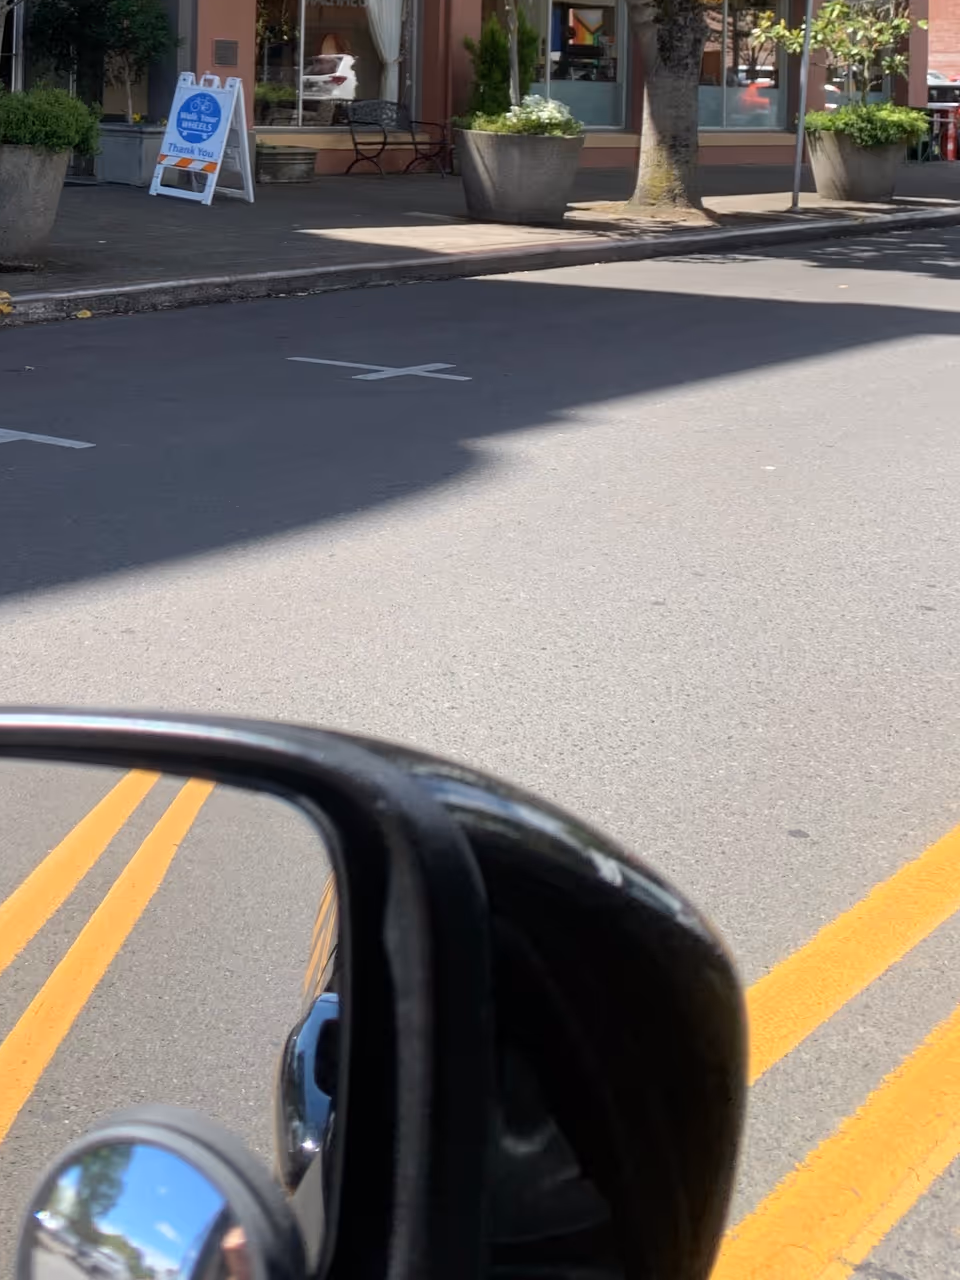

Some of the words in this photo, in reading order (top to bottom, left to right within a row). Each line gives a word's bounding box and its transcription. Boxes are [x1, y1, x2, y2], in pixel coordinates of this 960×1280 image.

[181, 121, 212, 131] WHEELS
[168, 143, 195, 155] Thank
[198, 146, 214, 158] You
